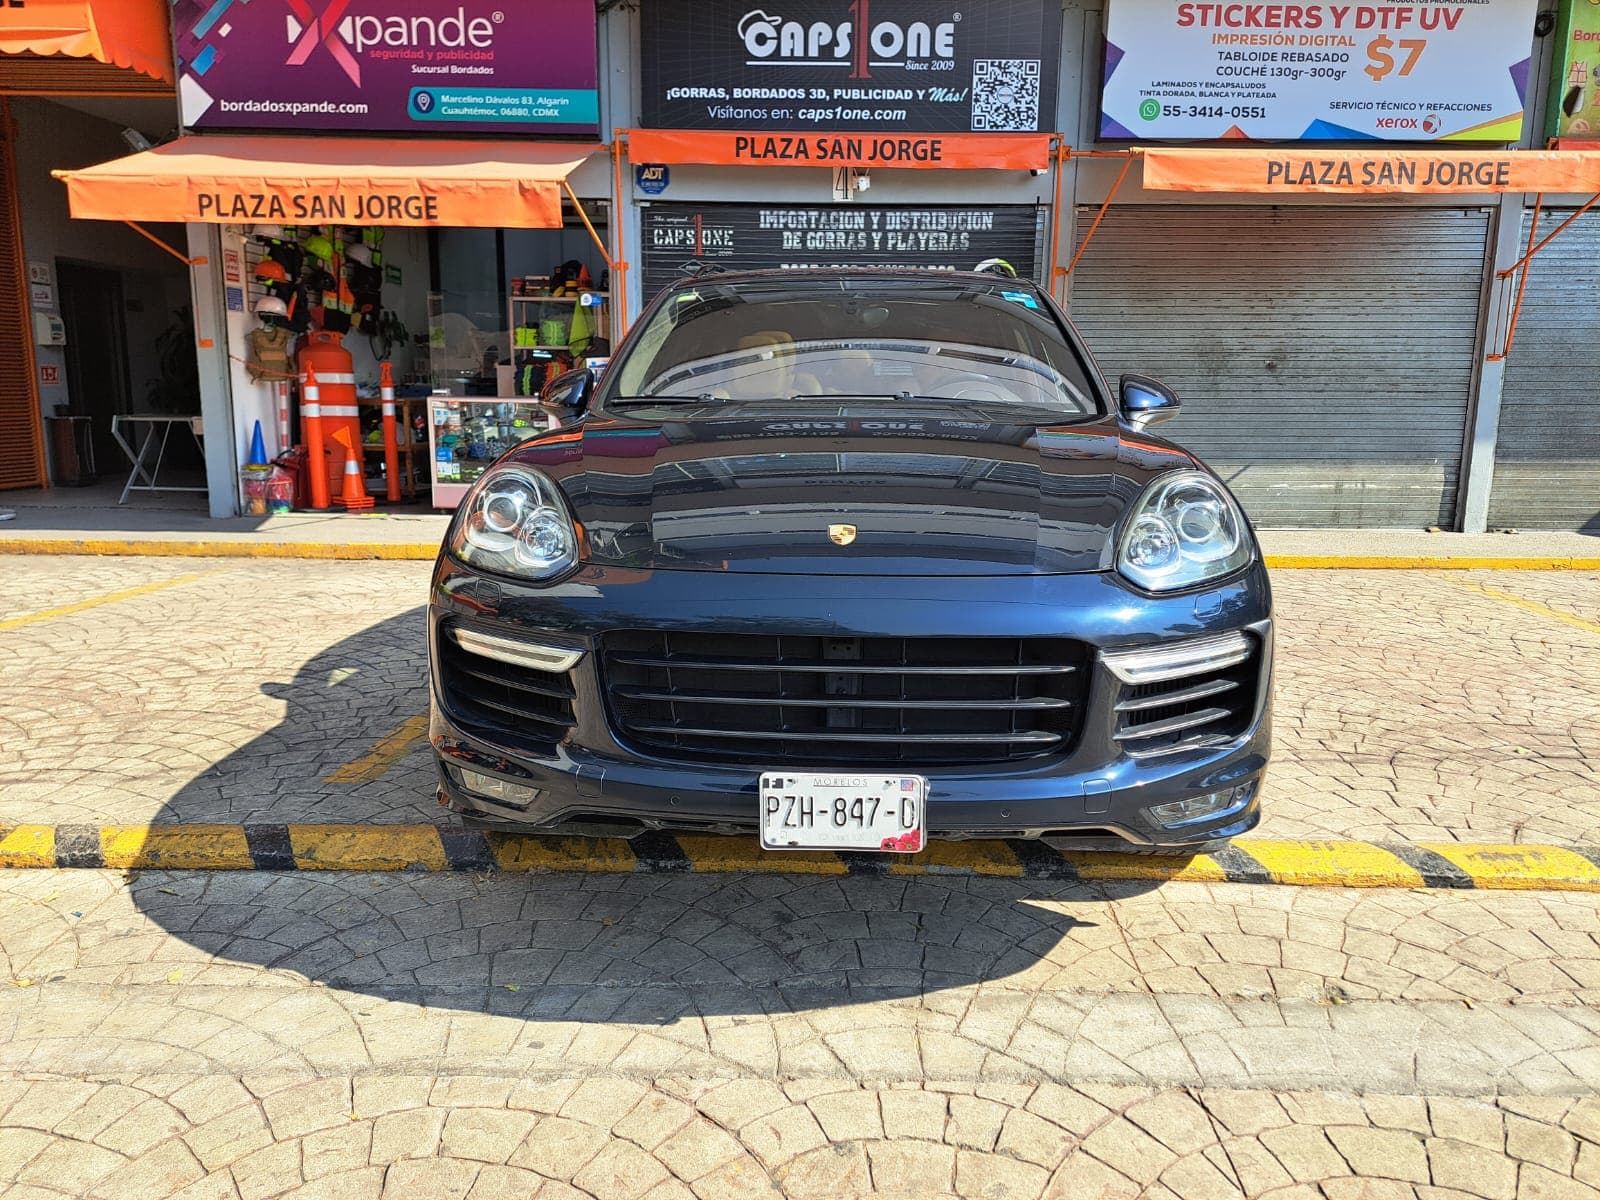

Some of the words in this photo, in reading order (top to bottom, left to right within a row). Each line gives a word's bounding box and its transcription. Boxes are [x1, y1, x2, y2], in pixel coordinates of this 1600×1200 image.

[1177, 3, 1323, 29] STICKERS
[1330, 6, 1351, 29] Y
[1354, 6, 1413, 30] DTF
[1419, 7, 1465, 31] UV
[1212, 32, 1295, 46] IMPRESIÓN
[1299, 34, 1357, 47] DIGITAL
[370, 49, 424, 60] seguridad
[427, 51, 434, 61] y
[437, 50, 494, 61] publicidad
[1218, 51, 1277, 62] TABLOIDE
[1281, 52, 1349, 63] REBASADO
[1363, 34, 1427, 82] $7
[411, 64, 449, 74] Sucursal
[450, 65, 494, 75] Bordados
[905, 60, 929, 71] Since
[931, 60, 955, 71] 2009
[1216, 65, 1267, 77] COUCHÉ
[1270, 67, 1347, 81] 130gr-300gr
[1151, 81, 1198, 89] LAMINADOS
[441, 95, 484, 104] Marcelino
[733, 88, 805, 100] BORDADOS
[809, 89, 829, 101] 3D,
[833, 89, 913, 101] PUBLICIDAD
[916, 89, 925, 101] Y
[928, 87, 969, 102] Más!
[220, 98, 368, 116] bordadosxpande.com
[532, 108, 560, 117] CDMX
[1163, 105, 1267, 119] 55-3414-0551
[1329, 101, 1373, 111] SERVICIO
[1376, 100, 1417, 111] TÉCNICO
[1418, 103, 1425, 111] Y
[1426, 103, 1493, 112] REFACCIONES
[707, 105, 769, 120] Visítanos
[770, 108, 793, 120] en:
[798, 106, 907, 122] caps1one.com
[1376, 116, 1418, 129] xerox
[735, 135, 809, 160] PLAZA
[816, 138, 862, 161] SAN
[867, 138, 942, 162] JORGE
[641, 167, 665, 181] ADT
[1267, 160, 1353, 186] PLAZA
[1357, 161, 1415, 187] SAN
[1423, 161, 1511, 187] JORGE
[198, 193, 286, 219] PLAZA
[294, 194, 345, 219] SAN
[354, 195, 439, 220] JORGE
[759, 210, 865, 230] IMPORTACION
[870, 211, 881, 230] Y
[886, 211, 994, 231] DISTRIBUCION
[783, 231, 801, 250] DE
[807, 231, 867, 251] GORRAS
[872, 232, 882, 250] Y
[887, 232, 970, 252] PLAYERAS
[813, 778, 868, 787] MORELOS
